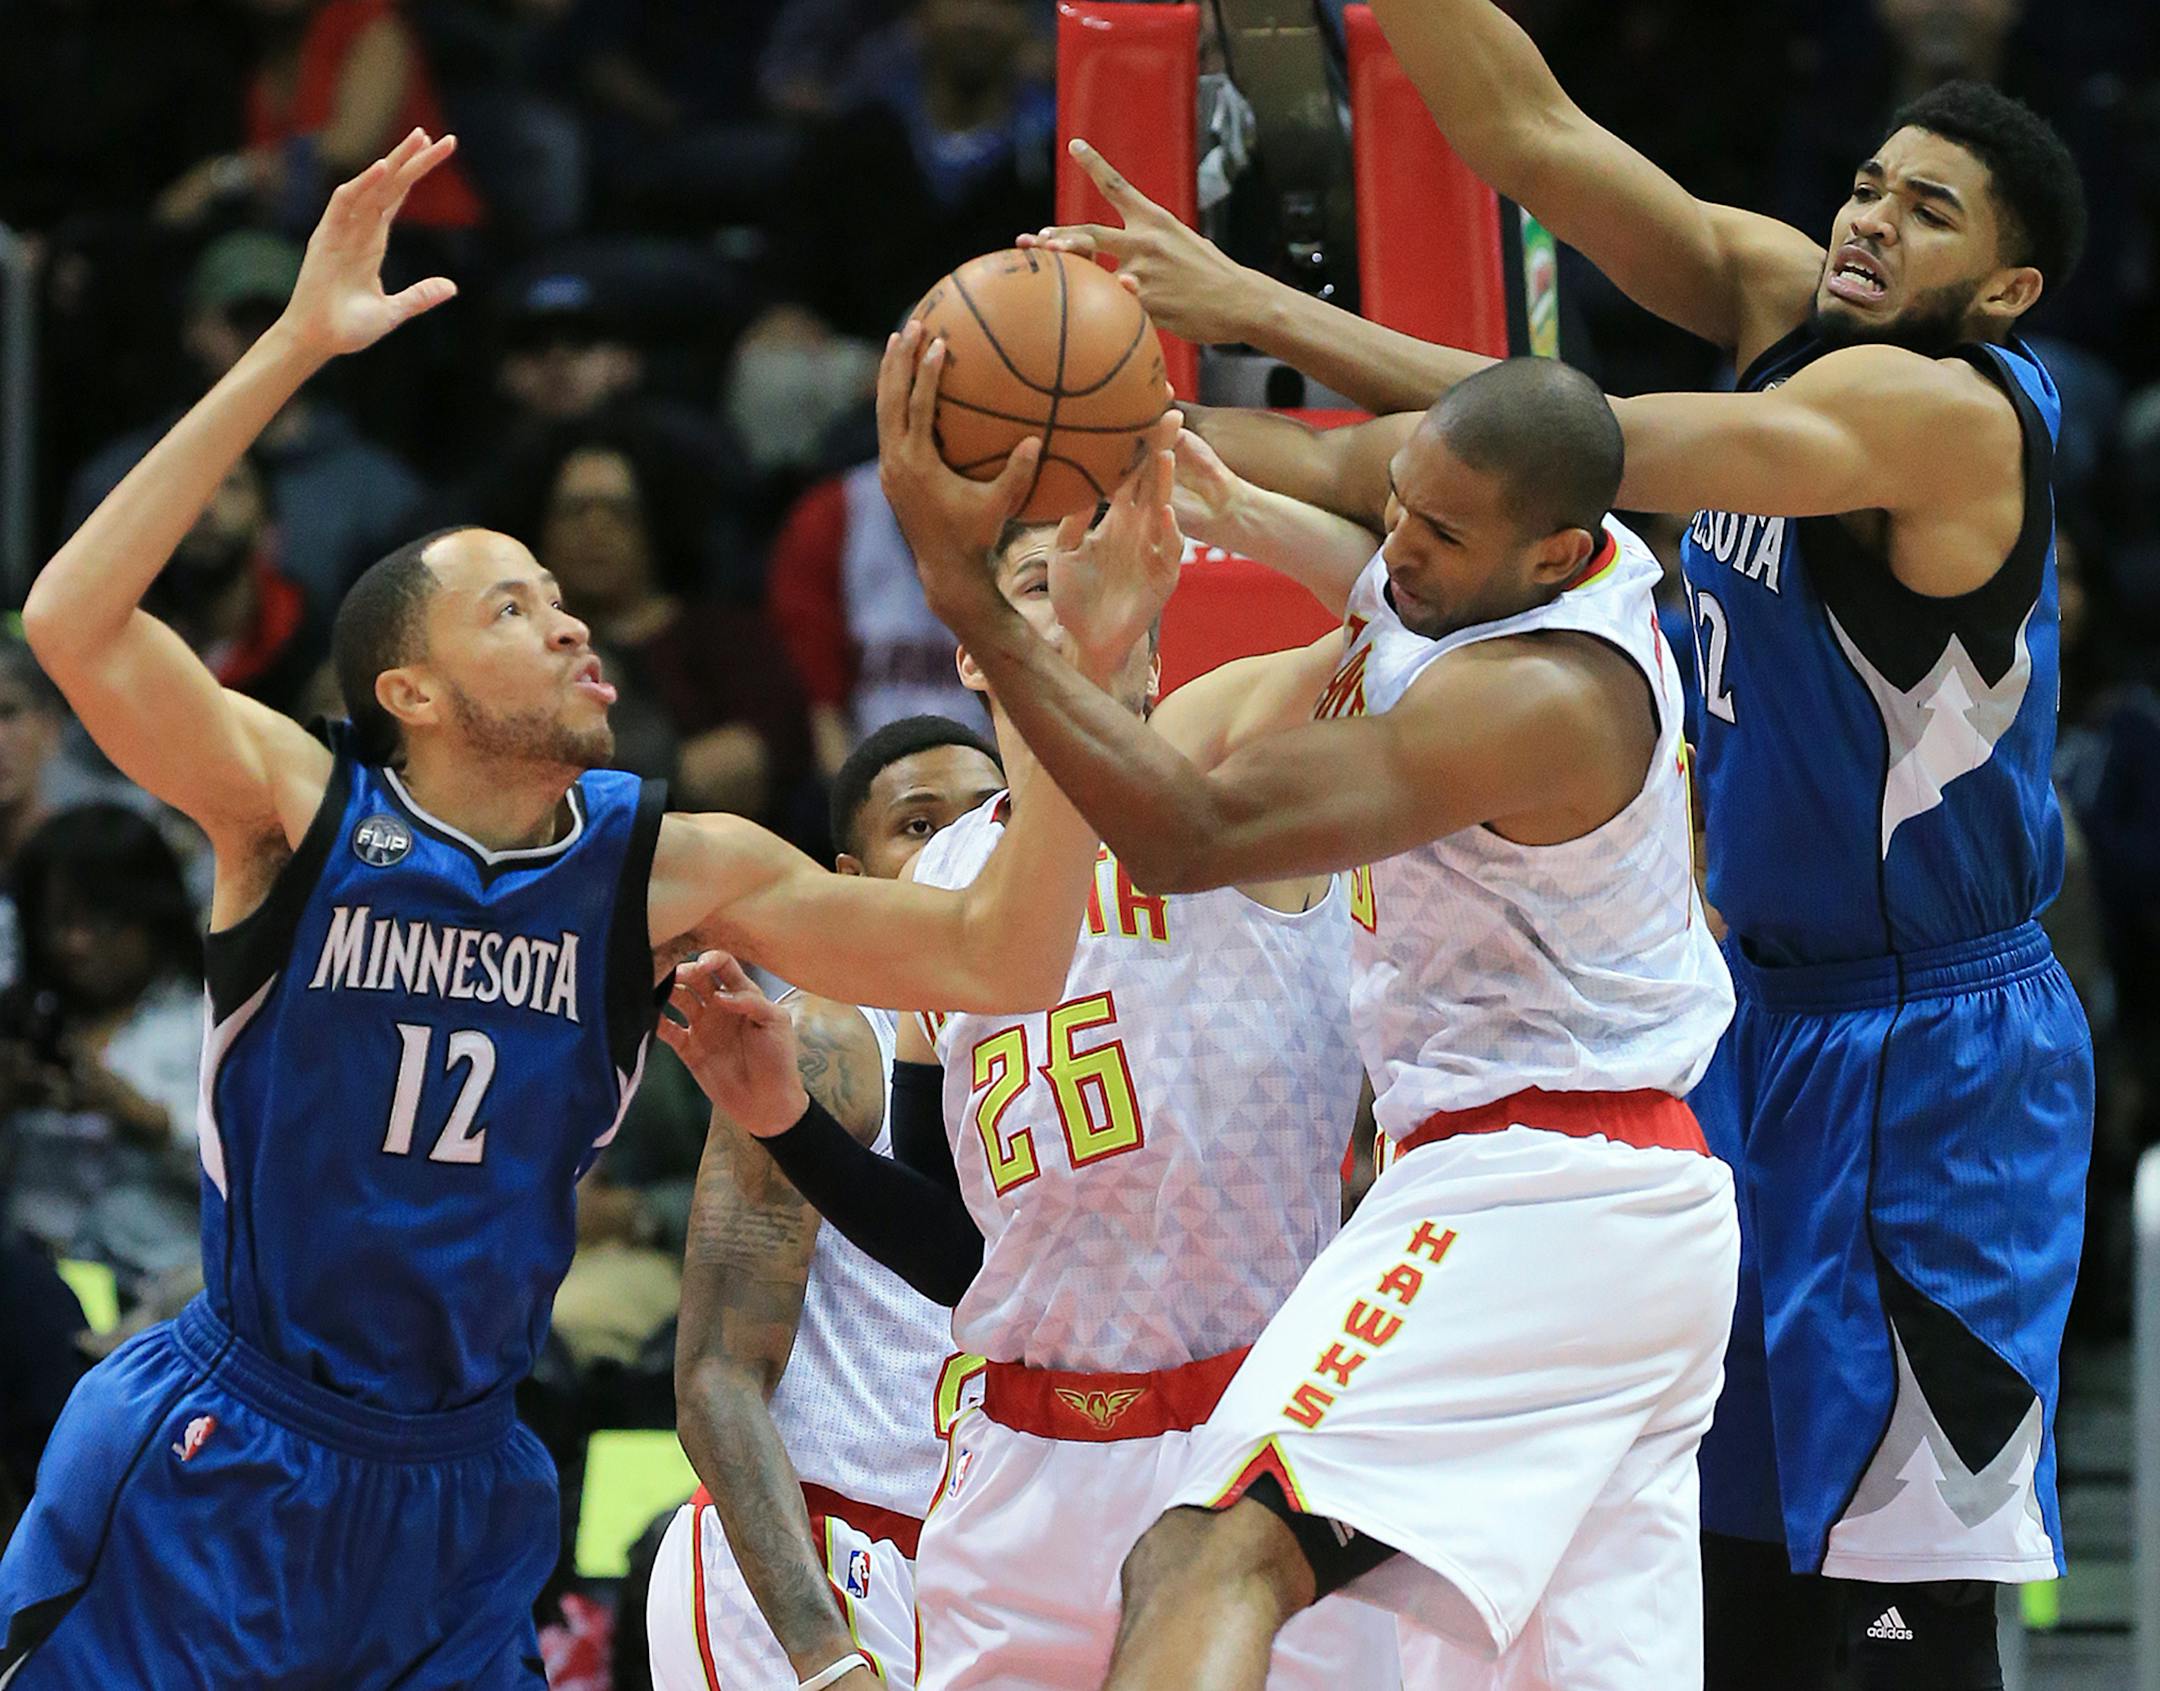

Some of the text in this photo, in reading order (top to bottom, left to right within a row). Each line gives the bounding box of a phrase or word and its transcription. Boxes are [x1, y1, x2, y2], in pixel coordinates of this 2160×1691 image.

[357, 828, 408, 851] FLIP
[308, 905, 580, 1024] MINNESOTA
[382, 1023, 497, 1164] 12
[972, 990, 1145, 1198] 26
[1281, 1219, 1458, 1430] HAWKS
[1866, 1625, 1914, 1641] adidas
